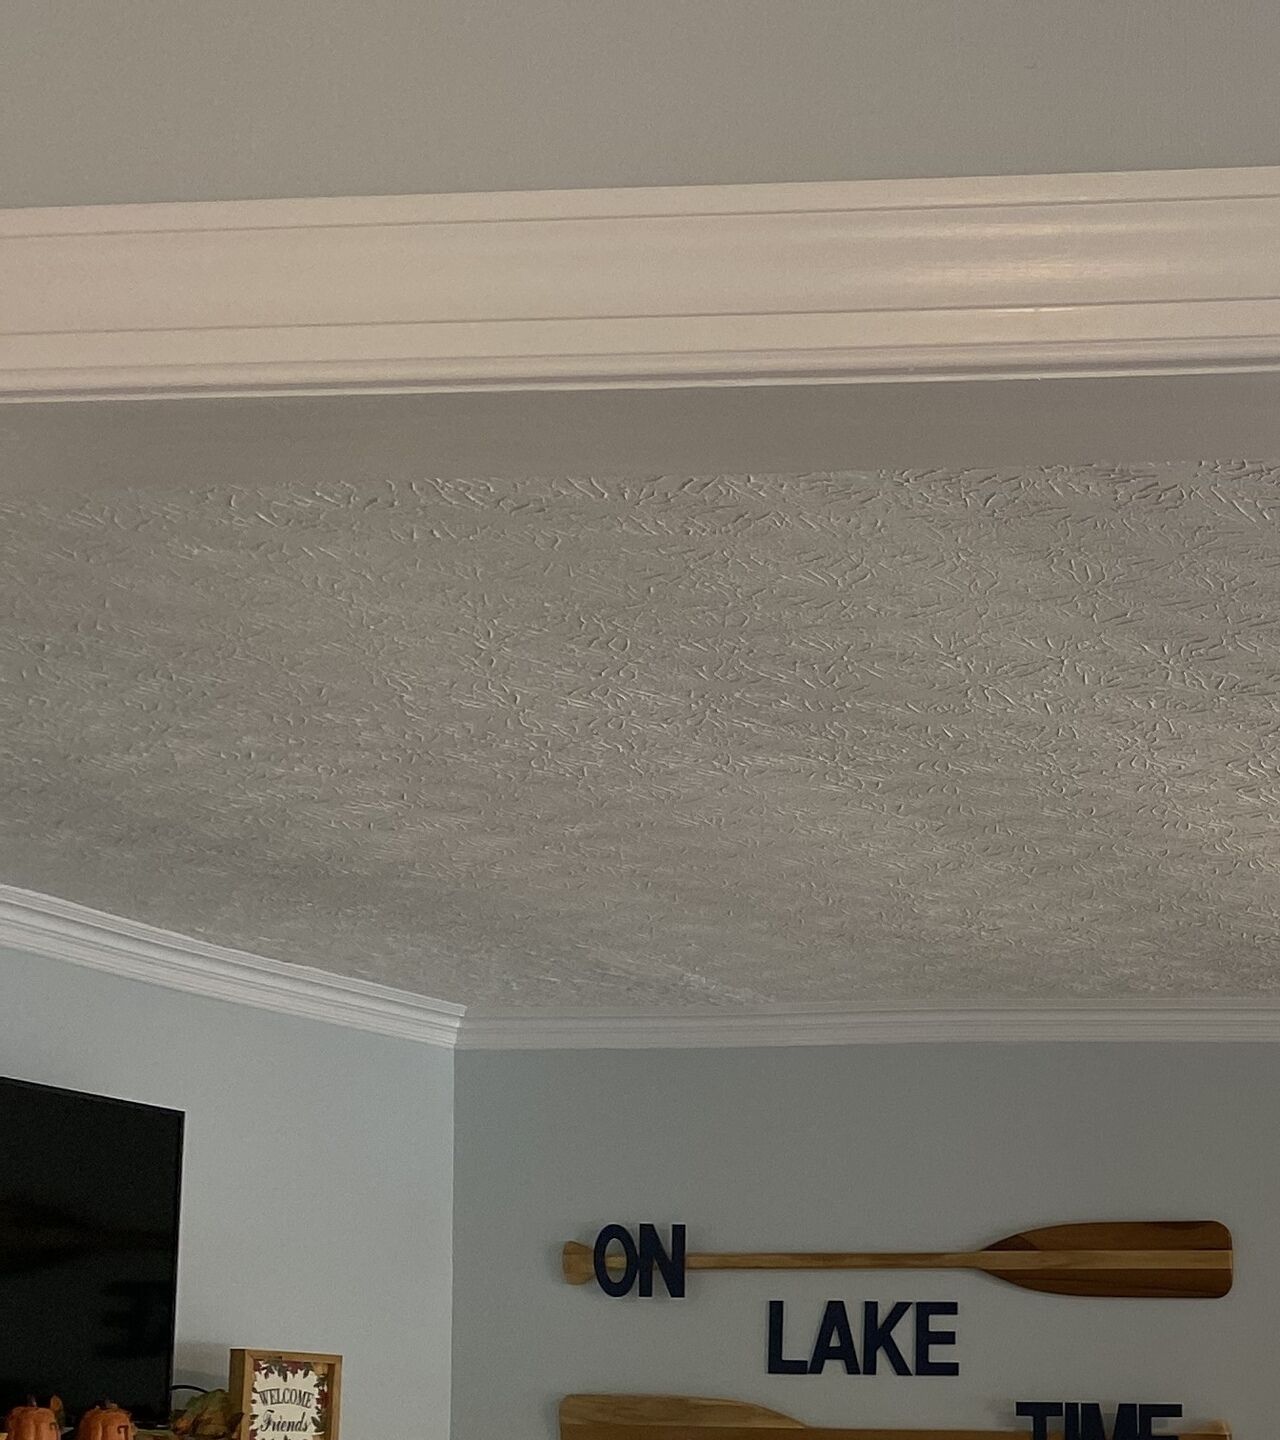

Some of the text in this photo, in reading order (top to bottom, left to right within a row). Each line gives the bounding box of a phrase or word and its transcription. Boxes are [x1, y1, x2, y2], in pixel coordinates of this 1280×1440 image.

[593, 1223, 687, 1298] ON
[767, 1300, 959, 1376] LAKE
[259, 1388, 315, 1409] WELCOME
[260, 1409, 309, 1432] Friends
